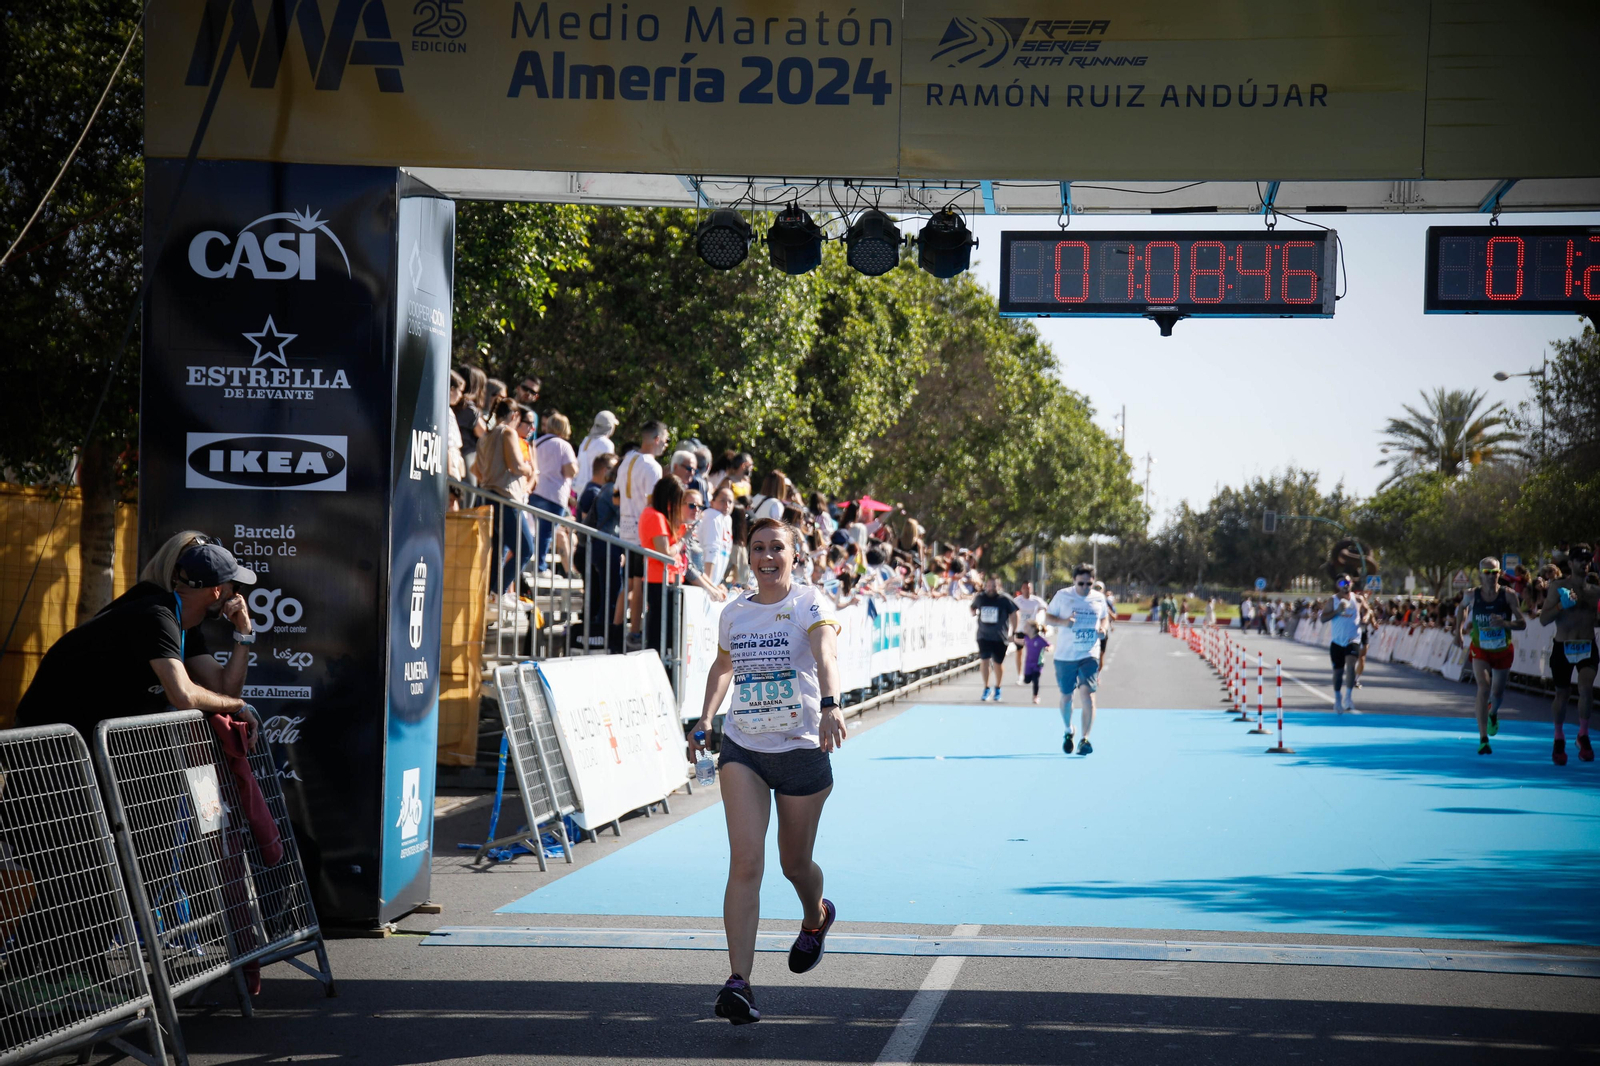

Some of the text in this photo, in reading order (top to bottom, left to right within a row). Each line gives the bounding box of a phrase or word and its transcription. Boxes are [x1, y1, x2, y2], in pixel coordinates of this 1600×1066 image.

[413, 0, 466, 37] 25
[511, 2, 892, 46] Medio Maratón
[411, 40, 466, 53] EDICIÓN
[1020, 40, 1102, 54] SERIES
[1013, 56, 1149, 68] RUTA RUNNING
[507, 50, 892, 106] Almería 2024
[927, 78, 1329, 108] RAMÓN RUIZ ANDÚJAR
[187, 229, 317, 281] CASI
[185, 366, 352, 389] ESTRELLA
[223, 388, 314, 400] DE LEVANTE
[208, 449, 329, 475] IKEA
[233, 524, 296, 540] Barceló
[233, 541, 297, 557] Cabo de
[273, 625, 307, 634] sport center
[750, 631, 789, 640] Maratón
[759, 638, 789, 648] 2024
[250, 687, 264, 697] de
[266, 687, 309, 697] Almería
[739, 680, 794, 702] 5193
